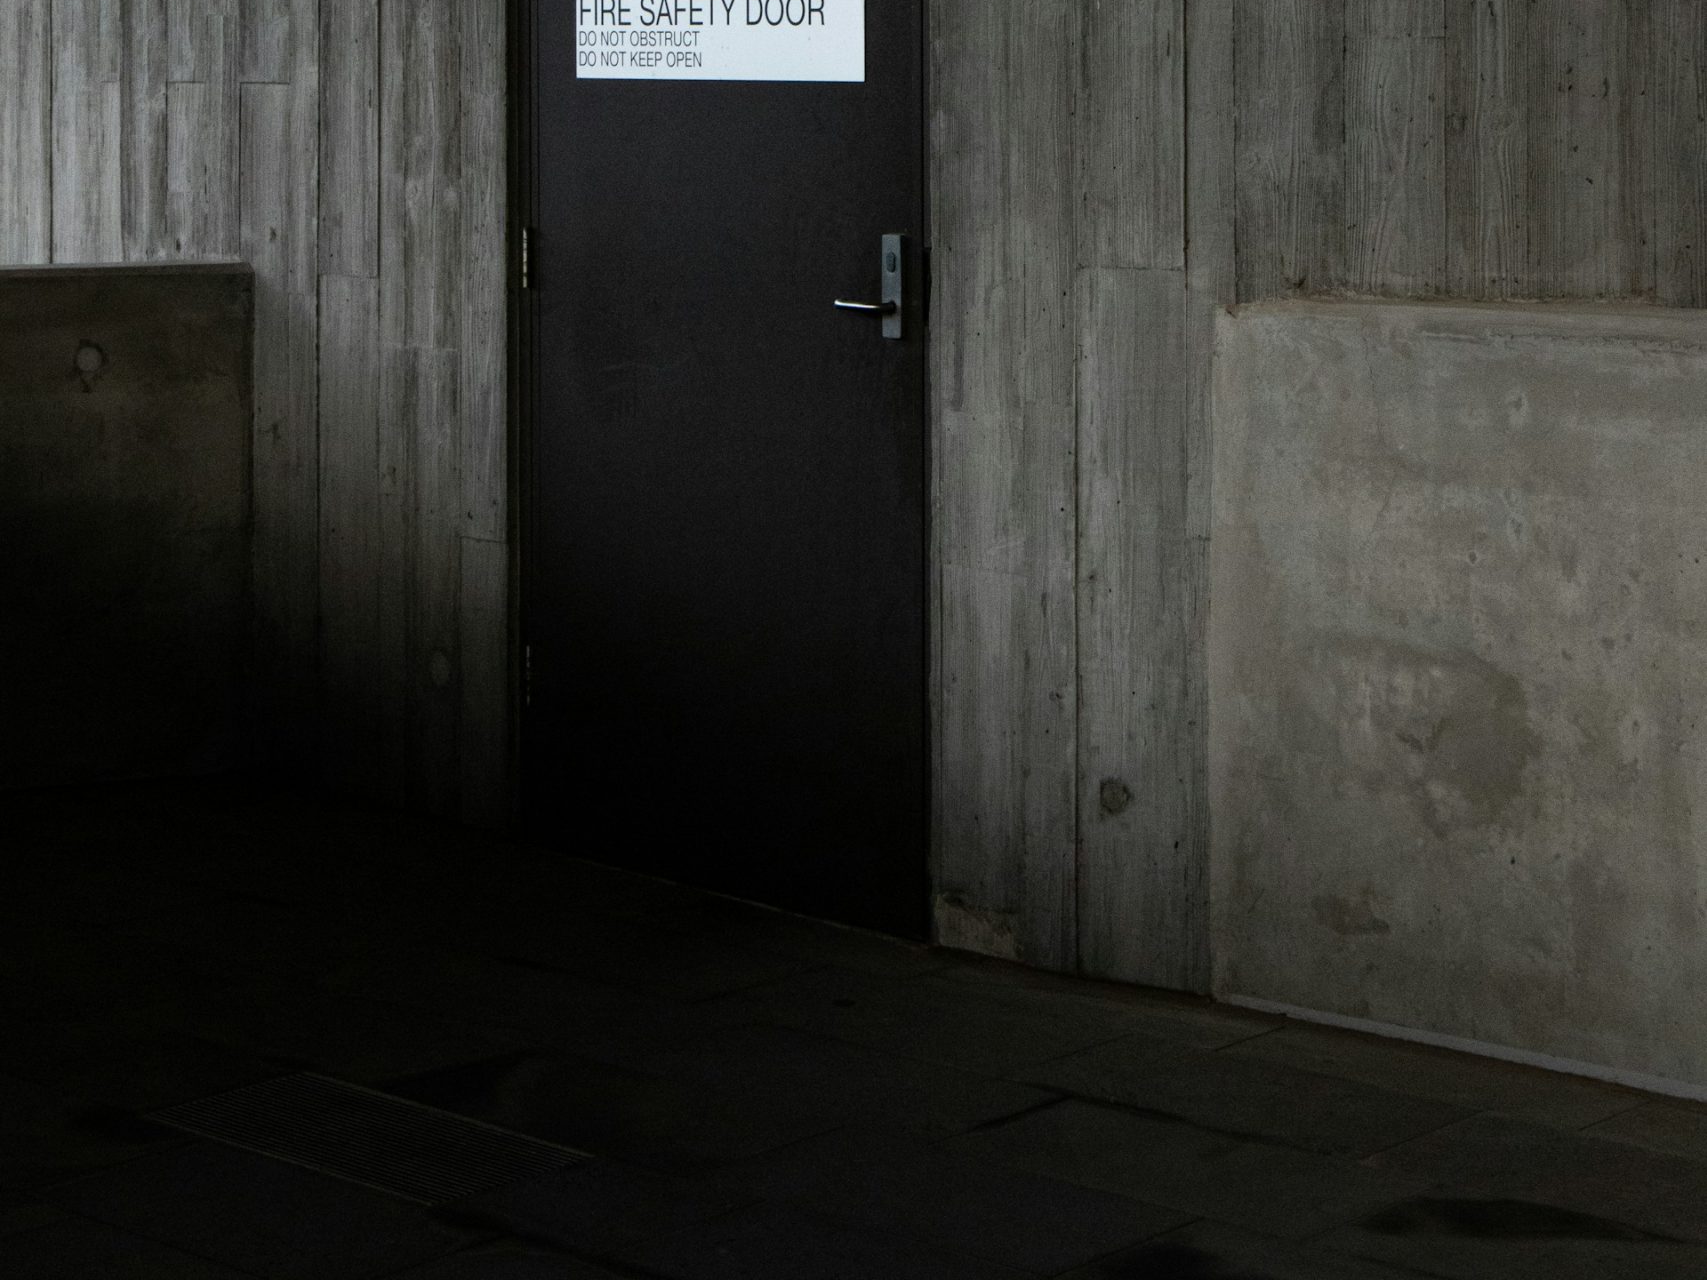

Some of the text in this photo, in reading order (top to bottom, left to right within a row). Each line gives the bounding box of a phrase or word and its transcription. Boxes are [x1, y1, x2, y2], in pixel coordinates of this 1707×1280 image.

[579, 30, 700, 47] DO NOT OBSTRUCT
[579, 51, 702, 68] DO NOT KEEP OPEN
